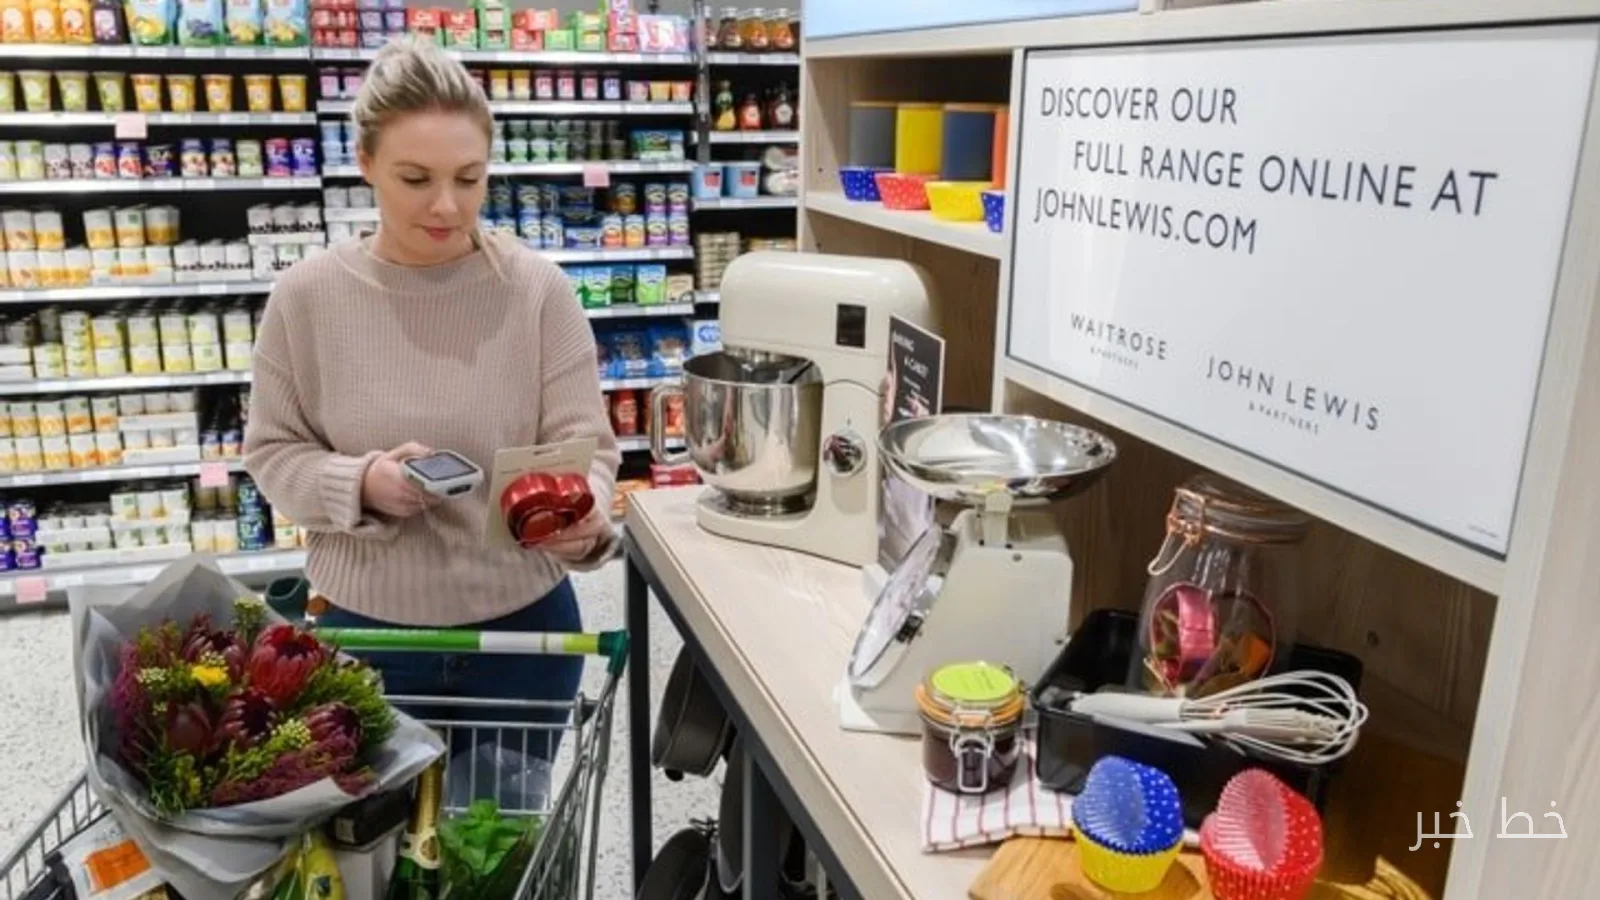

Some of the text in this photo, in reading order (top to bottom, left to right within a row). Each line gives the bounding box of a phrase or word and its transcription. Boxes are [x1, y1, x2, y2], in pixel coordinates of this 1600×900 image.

[1041, 86, 1237, 125] DISCOVER OUR
[1073, 140, 1499, 216] FULL RANGE ONLINE AT
[1034, 188, 1257, 255] JOHNLEWIS.COM
[1070, 313, 1167, 359] WAITROSE
[1206, 355, 1380, 431] JOHN LEWIS
[1258, 404, 1320, 434] PARTNERS
